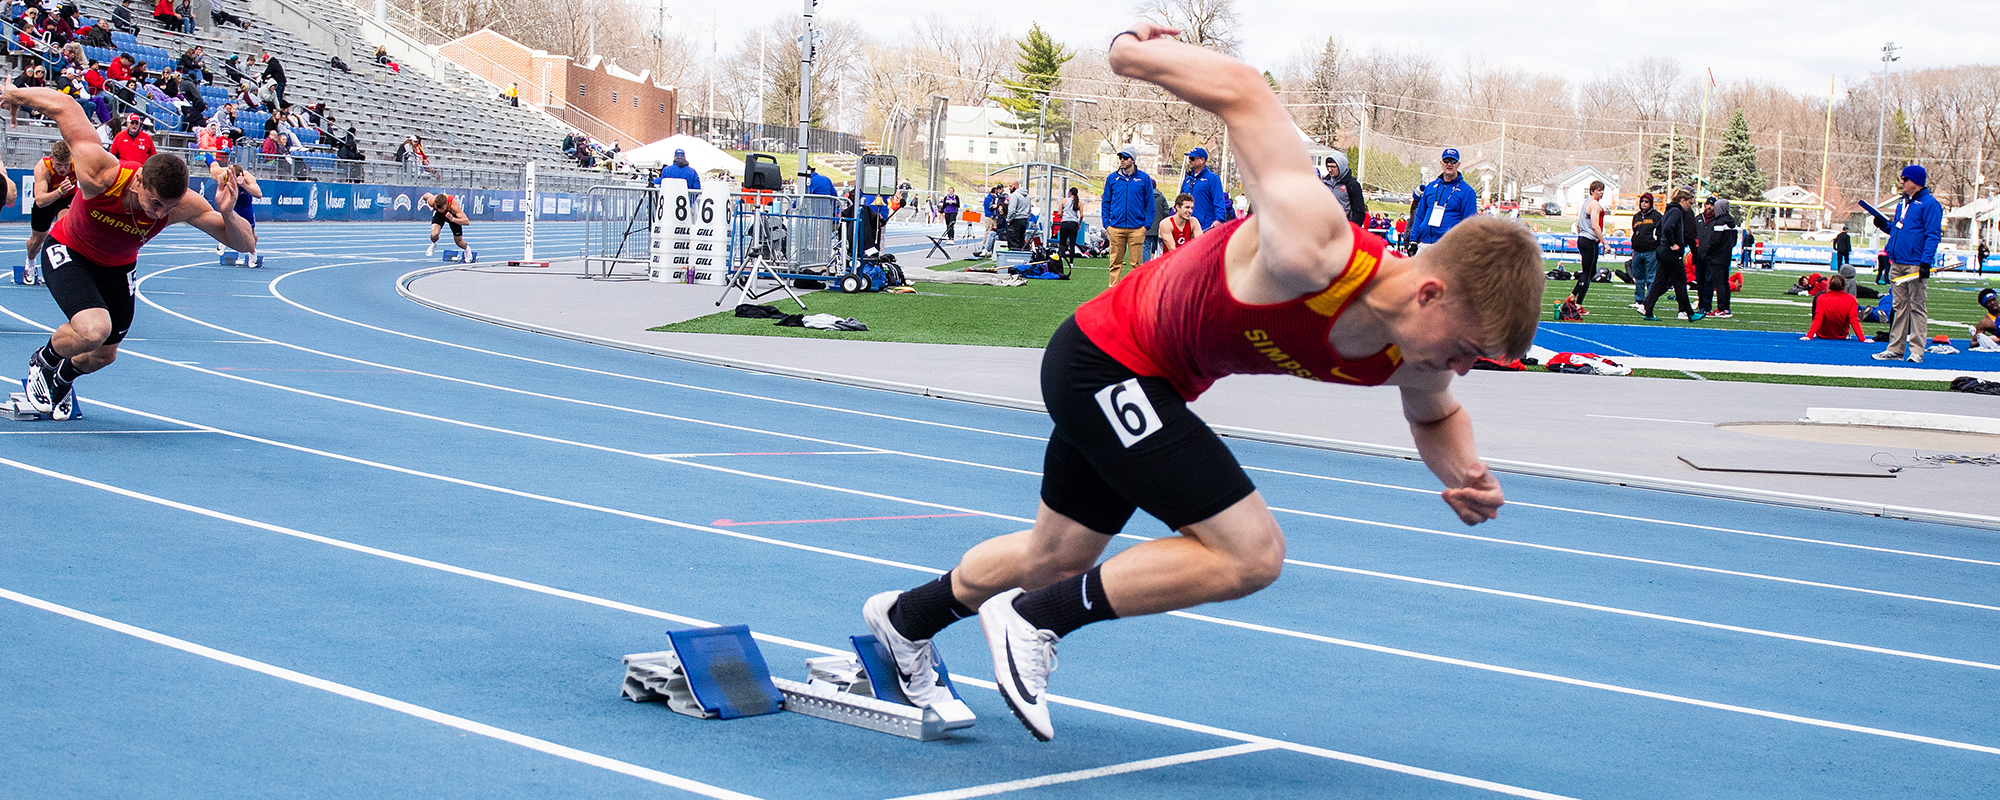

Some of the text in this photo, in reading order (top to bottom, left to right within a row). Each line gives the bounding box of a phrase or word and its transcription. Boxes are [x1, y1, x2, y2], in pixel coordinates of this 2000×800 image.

[864, 157, 892, 166] LAPS TO GO
[658, 195, 665, 221] 8
[675, 195, 688, 221] 8
[701, 198, 714, 224] 6
[90, 209, 148, 236] SIMPSON
[674, 227, 690, 235] GILL
[696, 228, 714, 236] GILL
[52, 245, 66, 265] 5
[696, 243, 713, 251] GILL
[695, 258, 712, 266] GILL
[695, 272, 712, 280] GILL
[1244, 329, 1322, 381] SIMPS
[1110, 384, 1147, 437] 6
